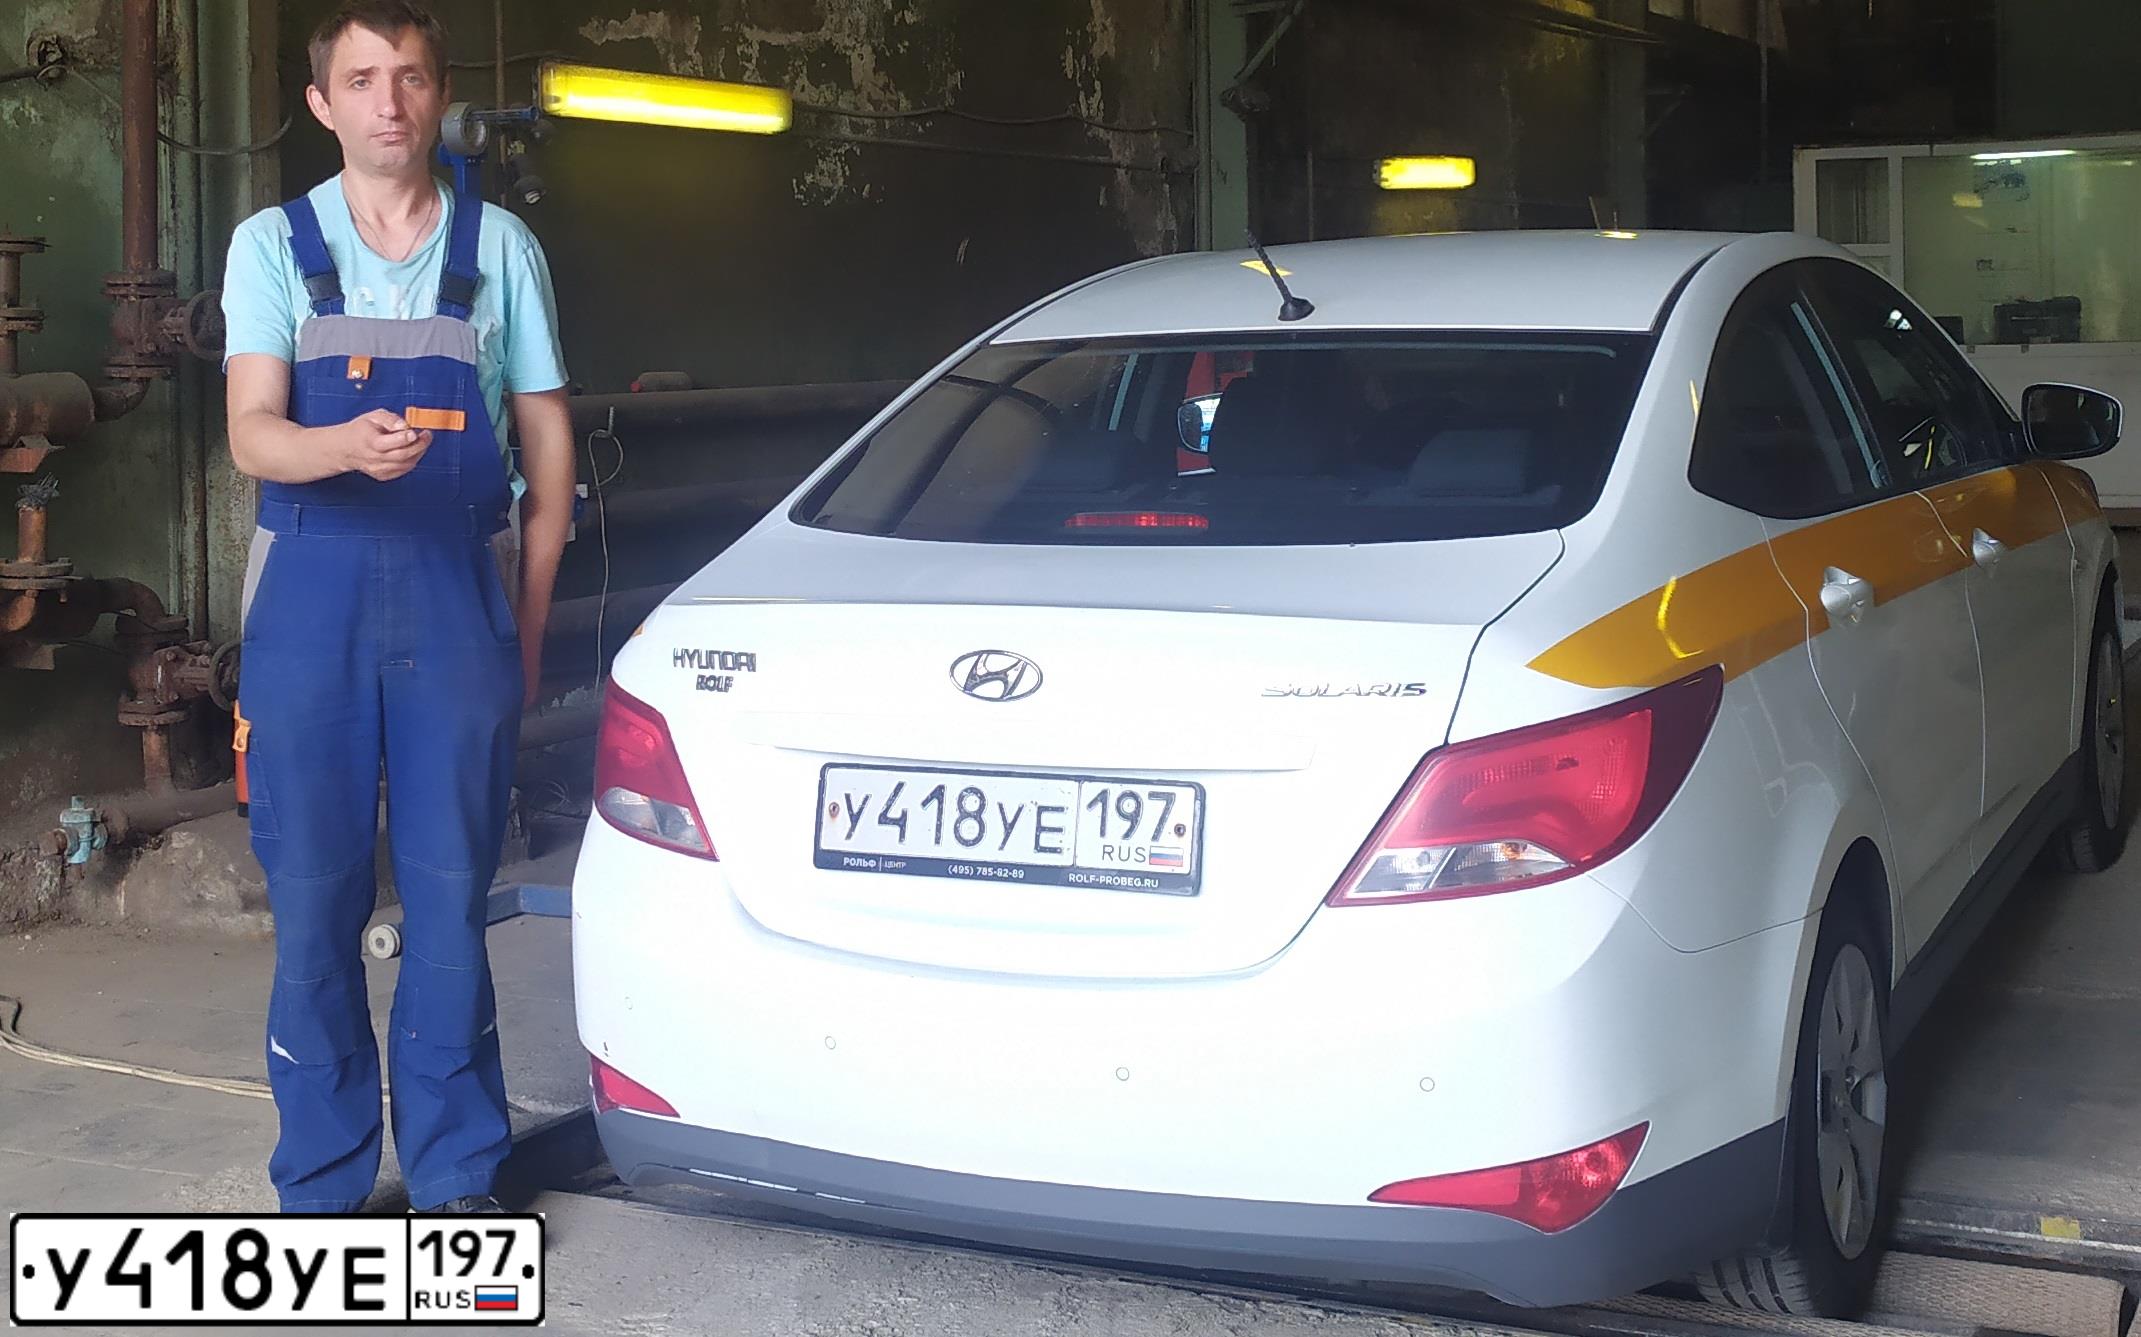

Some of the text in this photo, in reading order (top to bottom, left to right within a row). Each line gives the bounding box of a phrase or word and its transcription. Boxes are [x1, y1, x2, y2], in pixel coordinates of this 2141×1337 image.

[673, 647, 757, 673] HYUNDAI
[695, 673, 735, 693] ROLF
[1261, 682, 1428, 698] SOLARIS
[1086, 787, 1177, 843] 197
[843, 856, 877, 869] РОЛЬФ
[1101, 844, 1147, 864] RUS
[947, 864, 974, 877] (495)
[1068, 873, 1159, 889] ROLF-PROBEG.RU
